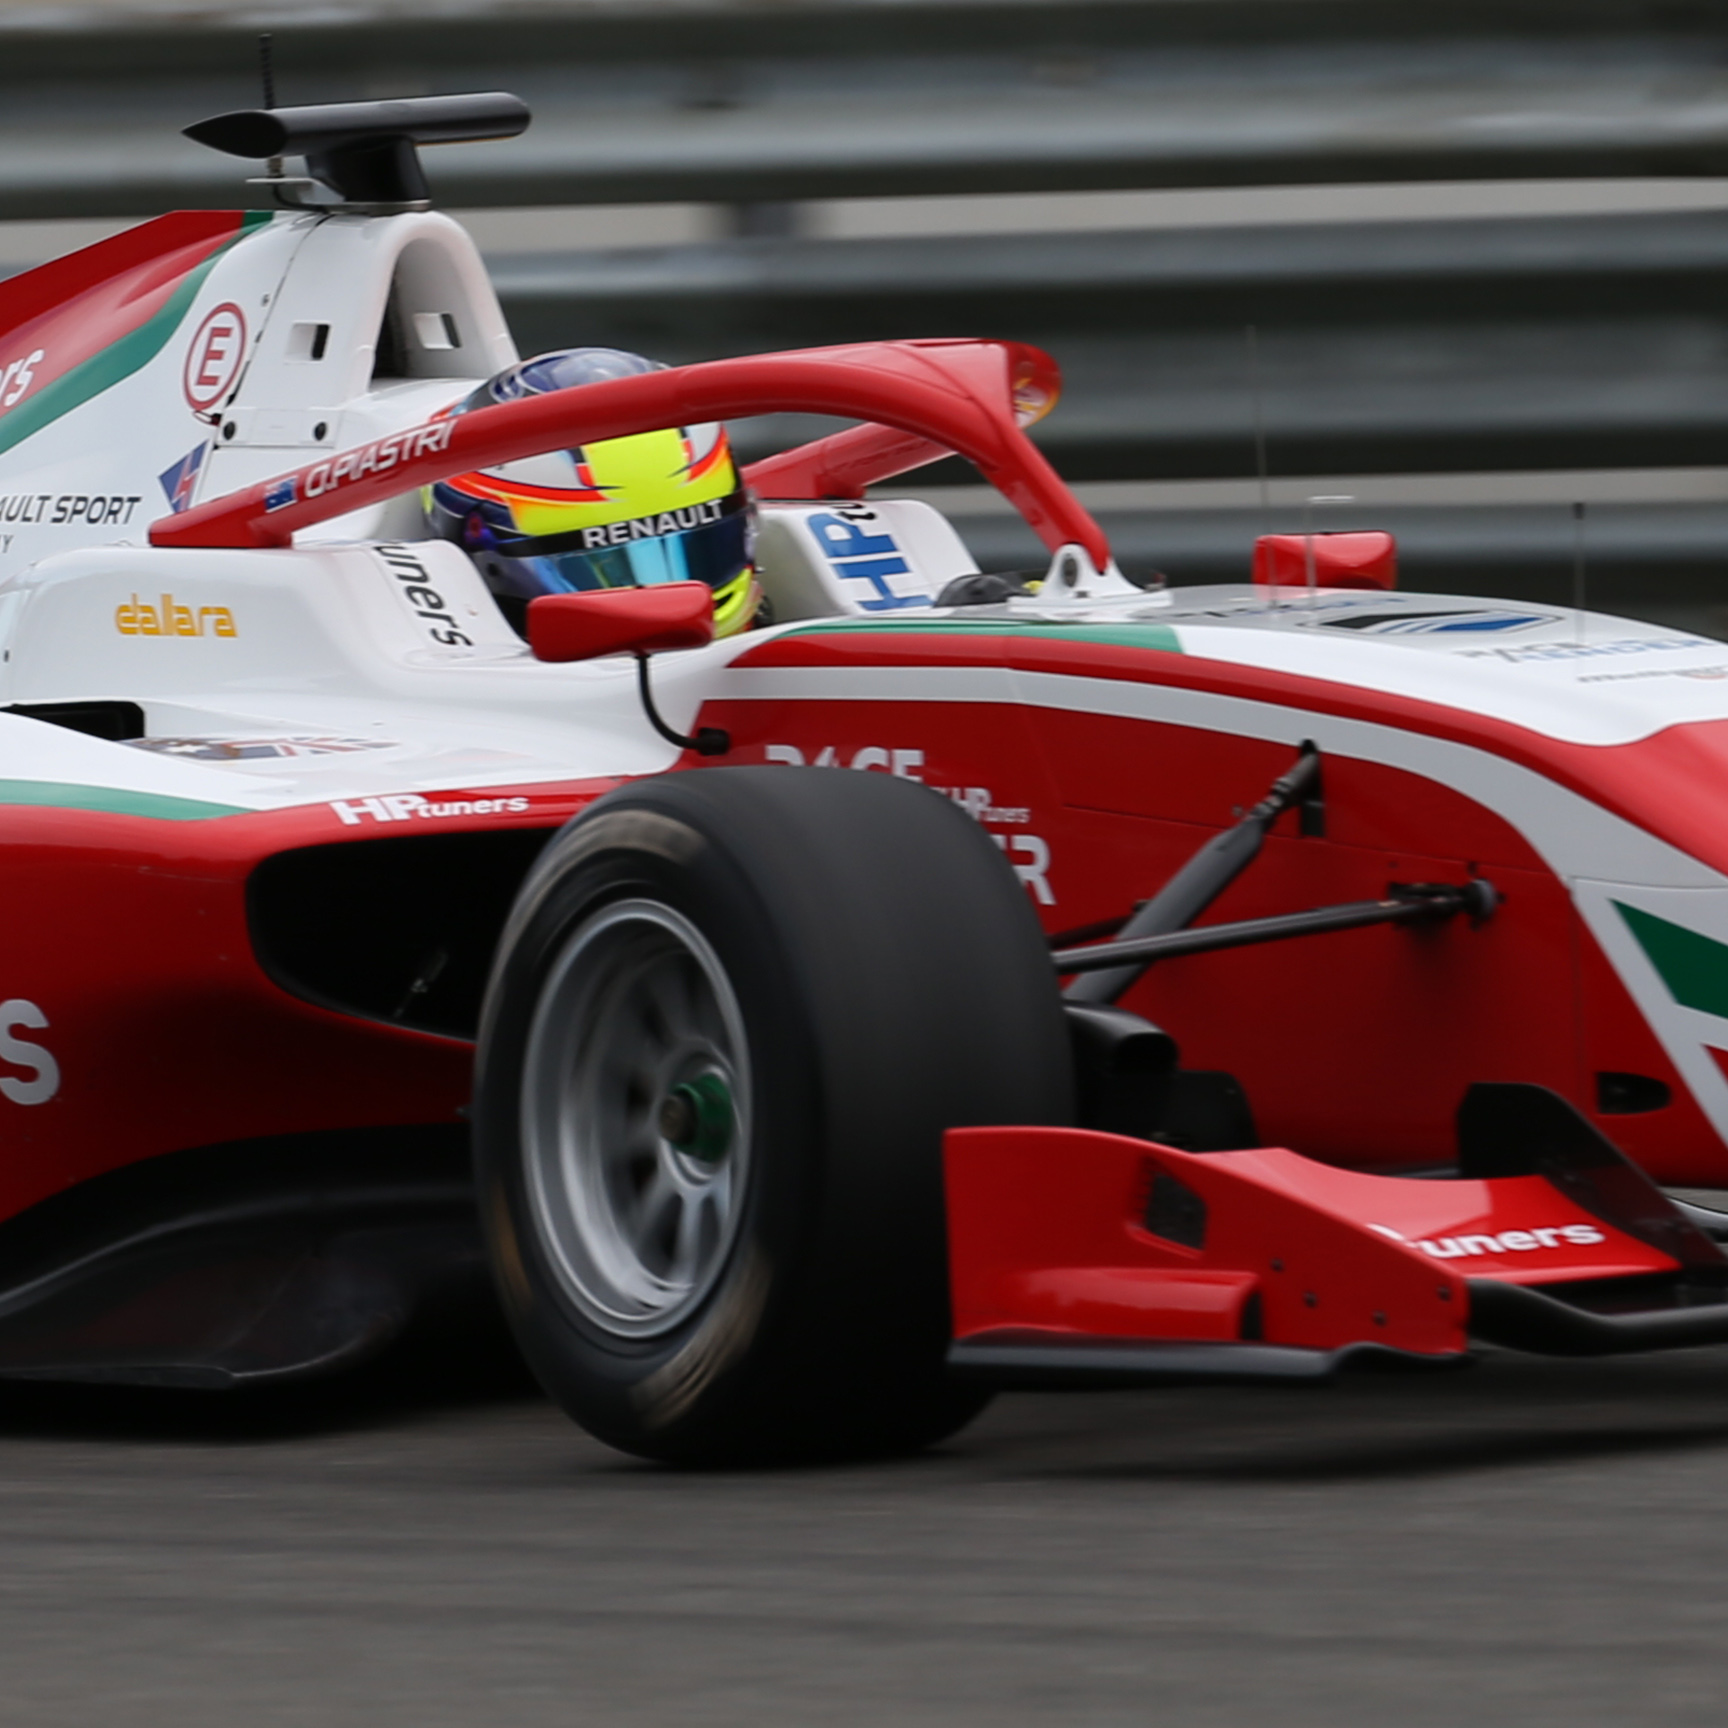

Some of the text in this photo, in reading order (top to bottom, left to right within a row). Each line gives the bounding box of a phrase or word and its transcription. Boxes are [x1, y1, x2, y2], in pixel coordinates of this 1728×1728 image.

[50, 494, 142, 524] SPORT
[582, 498, 722, 549] RENAULT
[115, 593, 238, 638] dallara
